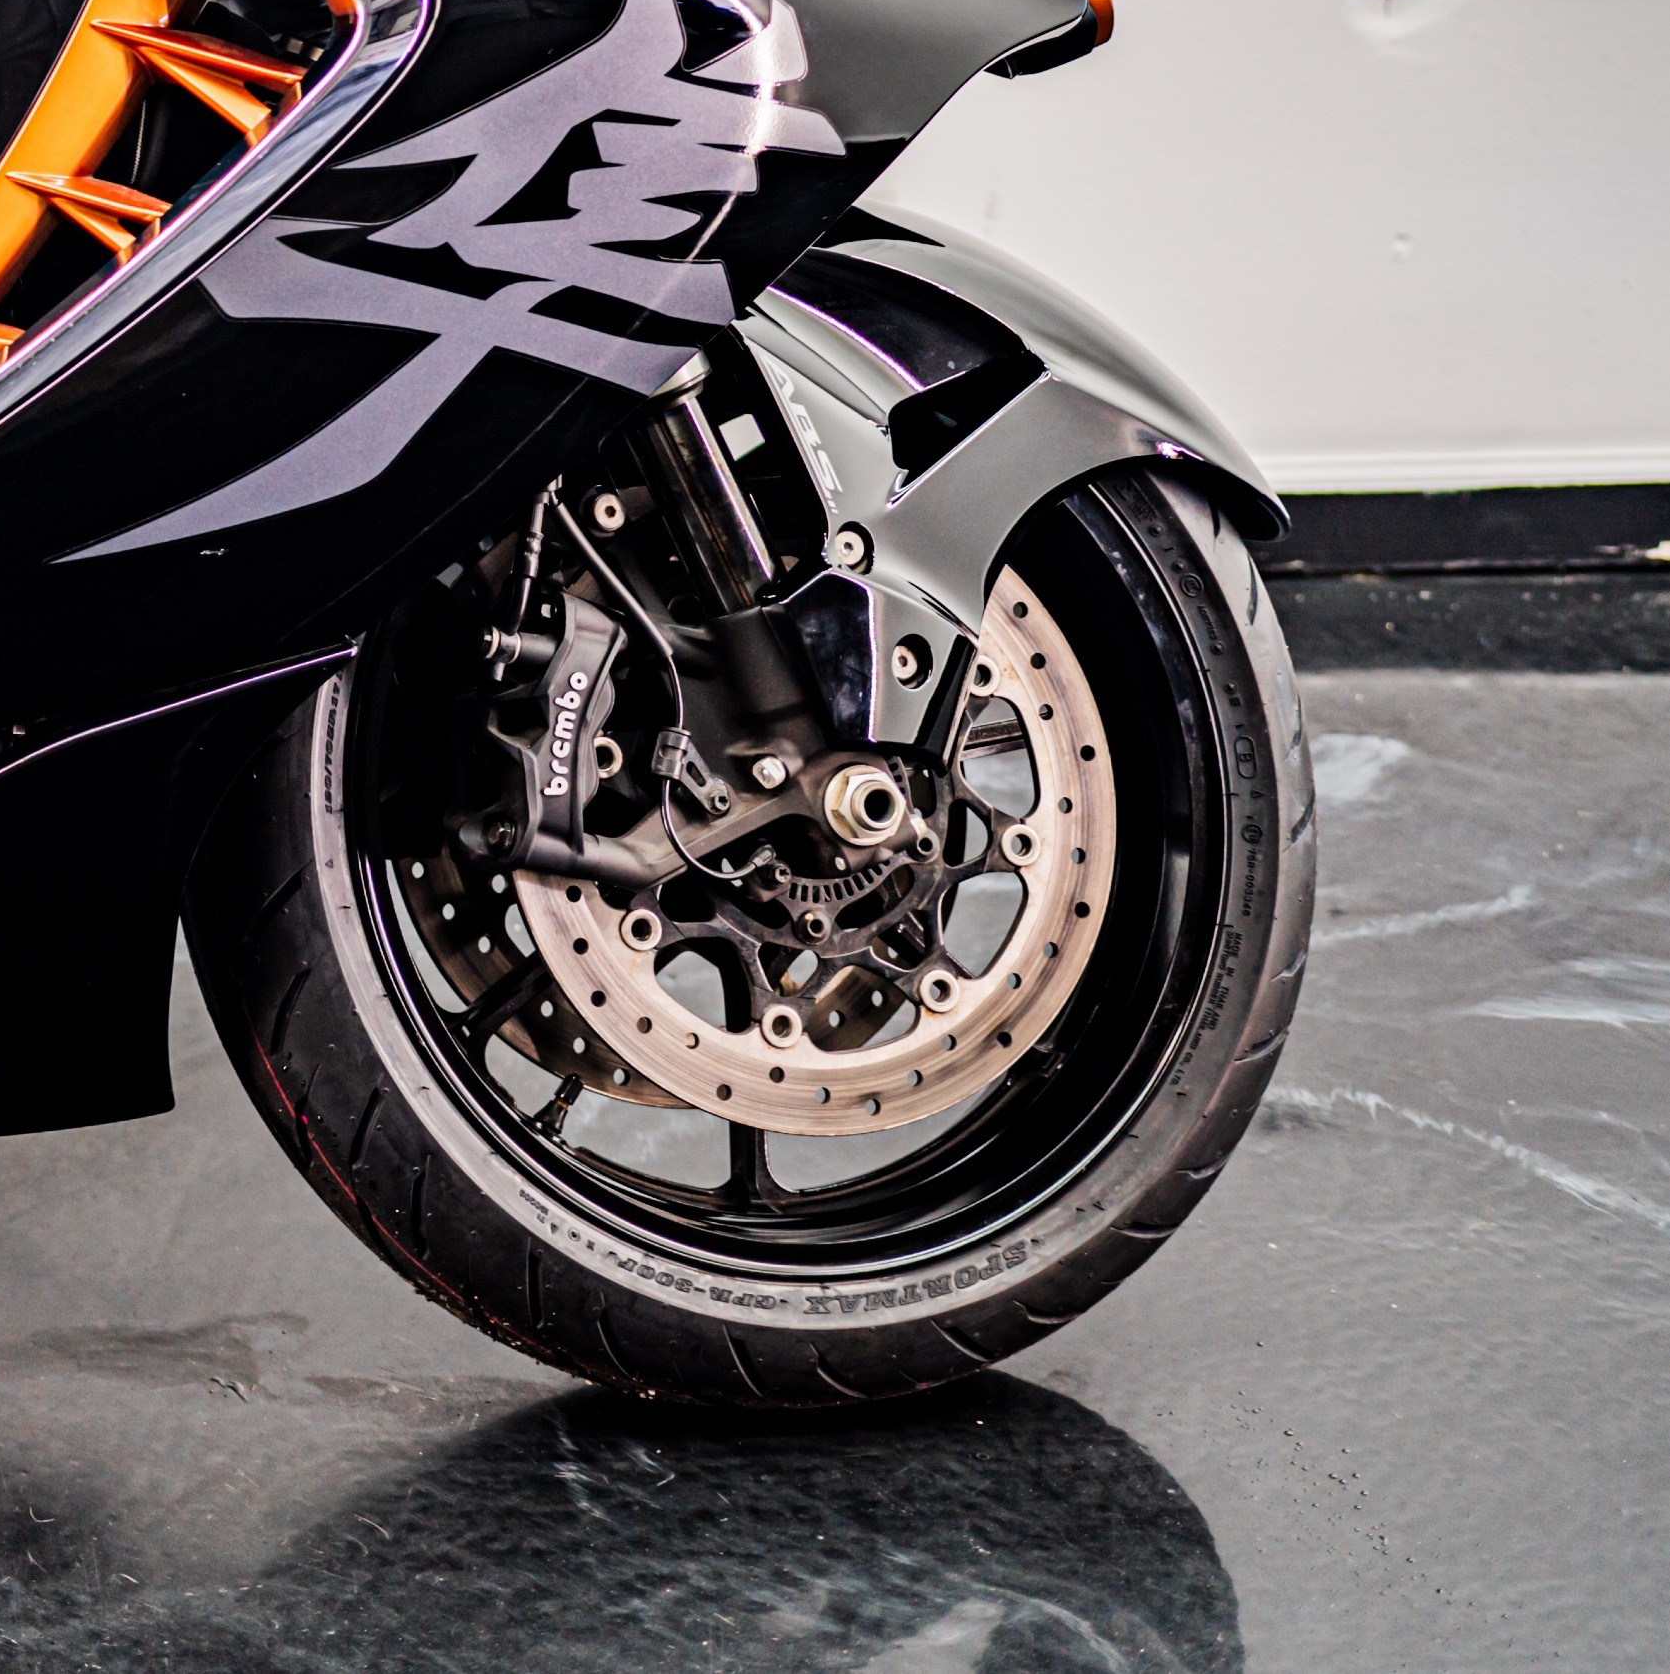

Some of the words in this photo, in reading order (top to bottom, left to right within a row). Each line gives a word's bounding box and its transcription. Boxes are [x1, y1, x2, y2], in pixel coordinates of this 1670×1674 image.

[758, 348, 844, 494] ABS
[543, 671, 589, 796] brembo
[1233, 931, 1243, 958] MADE
[1224, 967, 1236, 978] IN
[1209, 986, 1230, 1030] THAILAND
[618, 1257, 776, 1310] GPR-300F
[803, 1238, 1030, 1315] SPORTMAX
